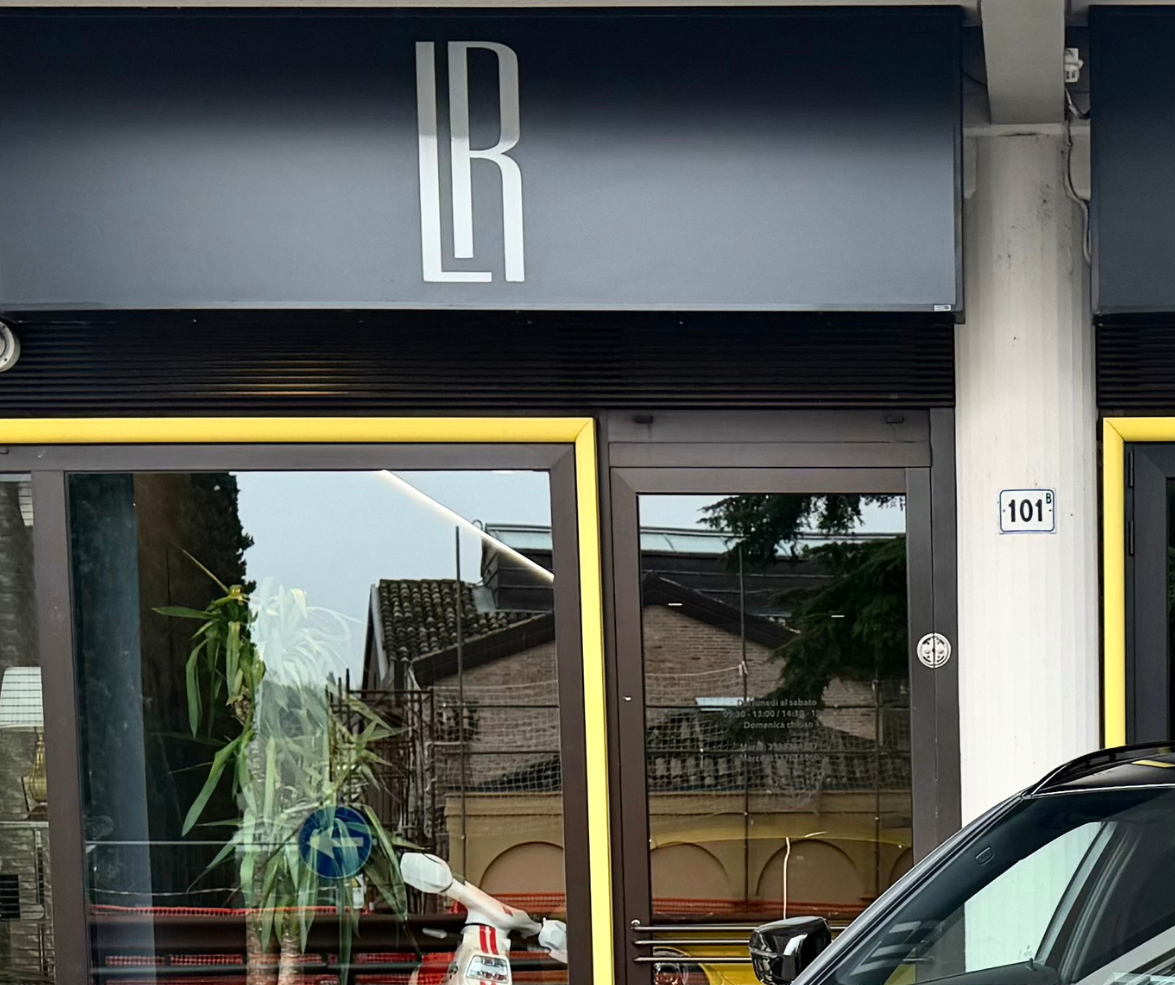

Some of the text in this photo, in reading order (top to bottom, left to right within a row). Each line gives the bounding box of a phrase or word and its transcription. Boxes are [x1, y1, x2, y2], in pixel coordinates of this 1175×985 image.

[415, 40, 525, 283] LR
[1008, 492, 1052, 523] 101 B
[789, 698, 817, 707] sabato
[743, 721, 785, 729] Domenica
